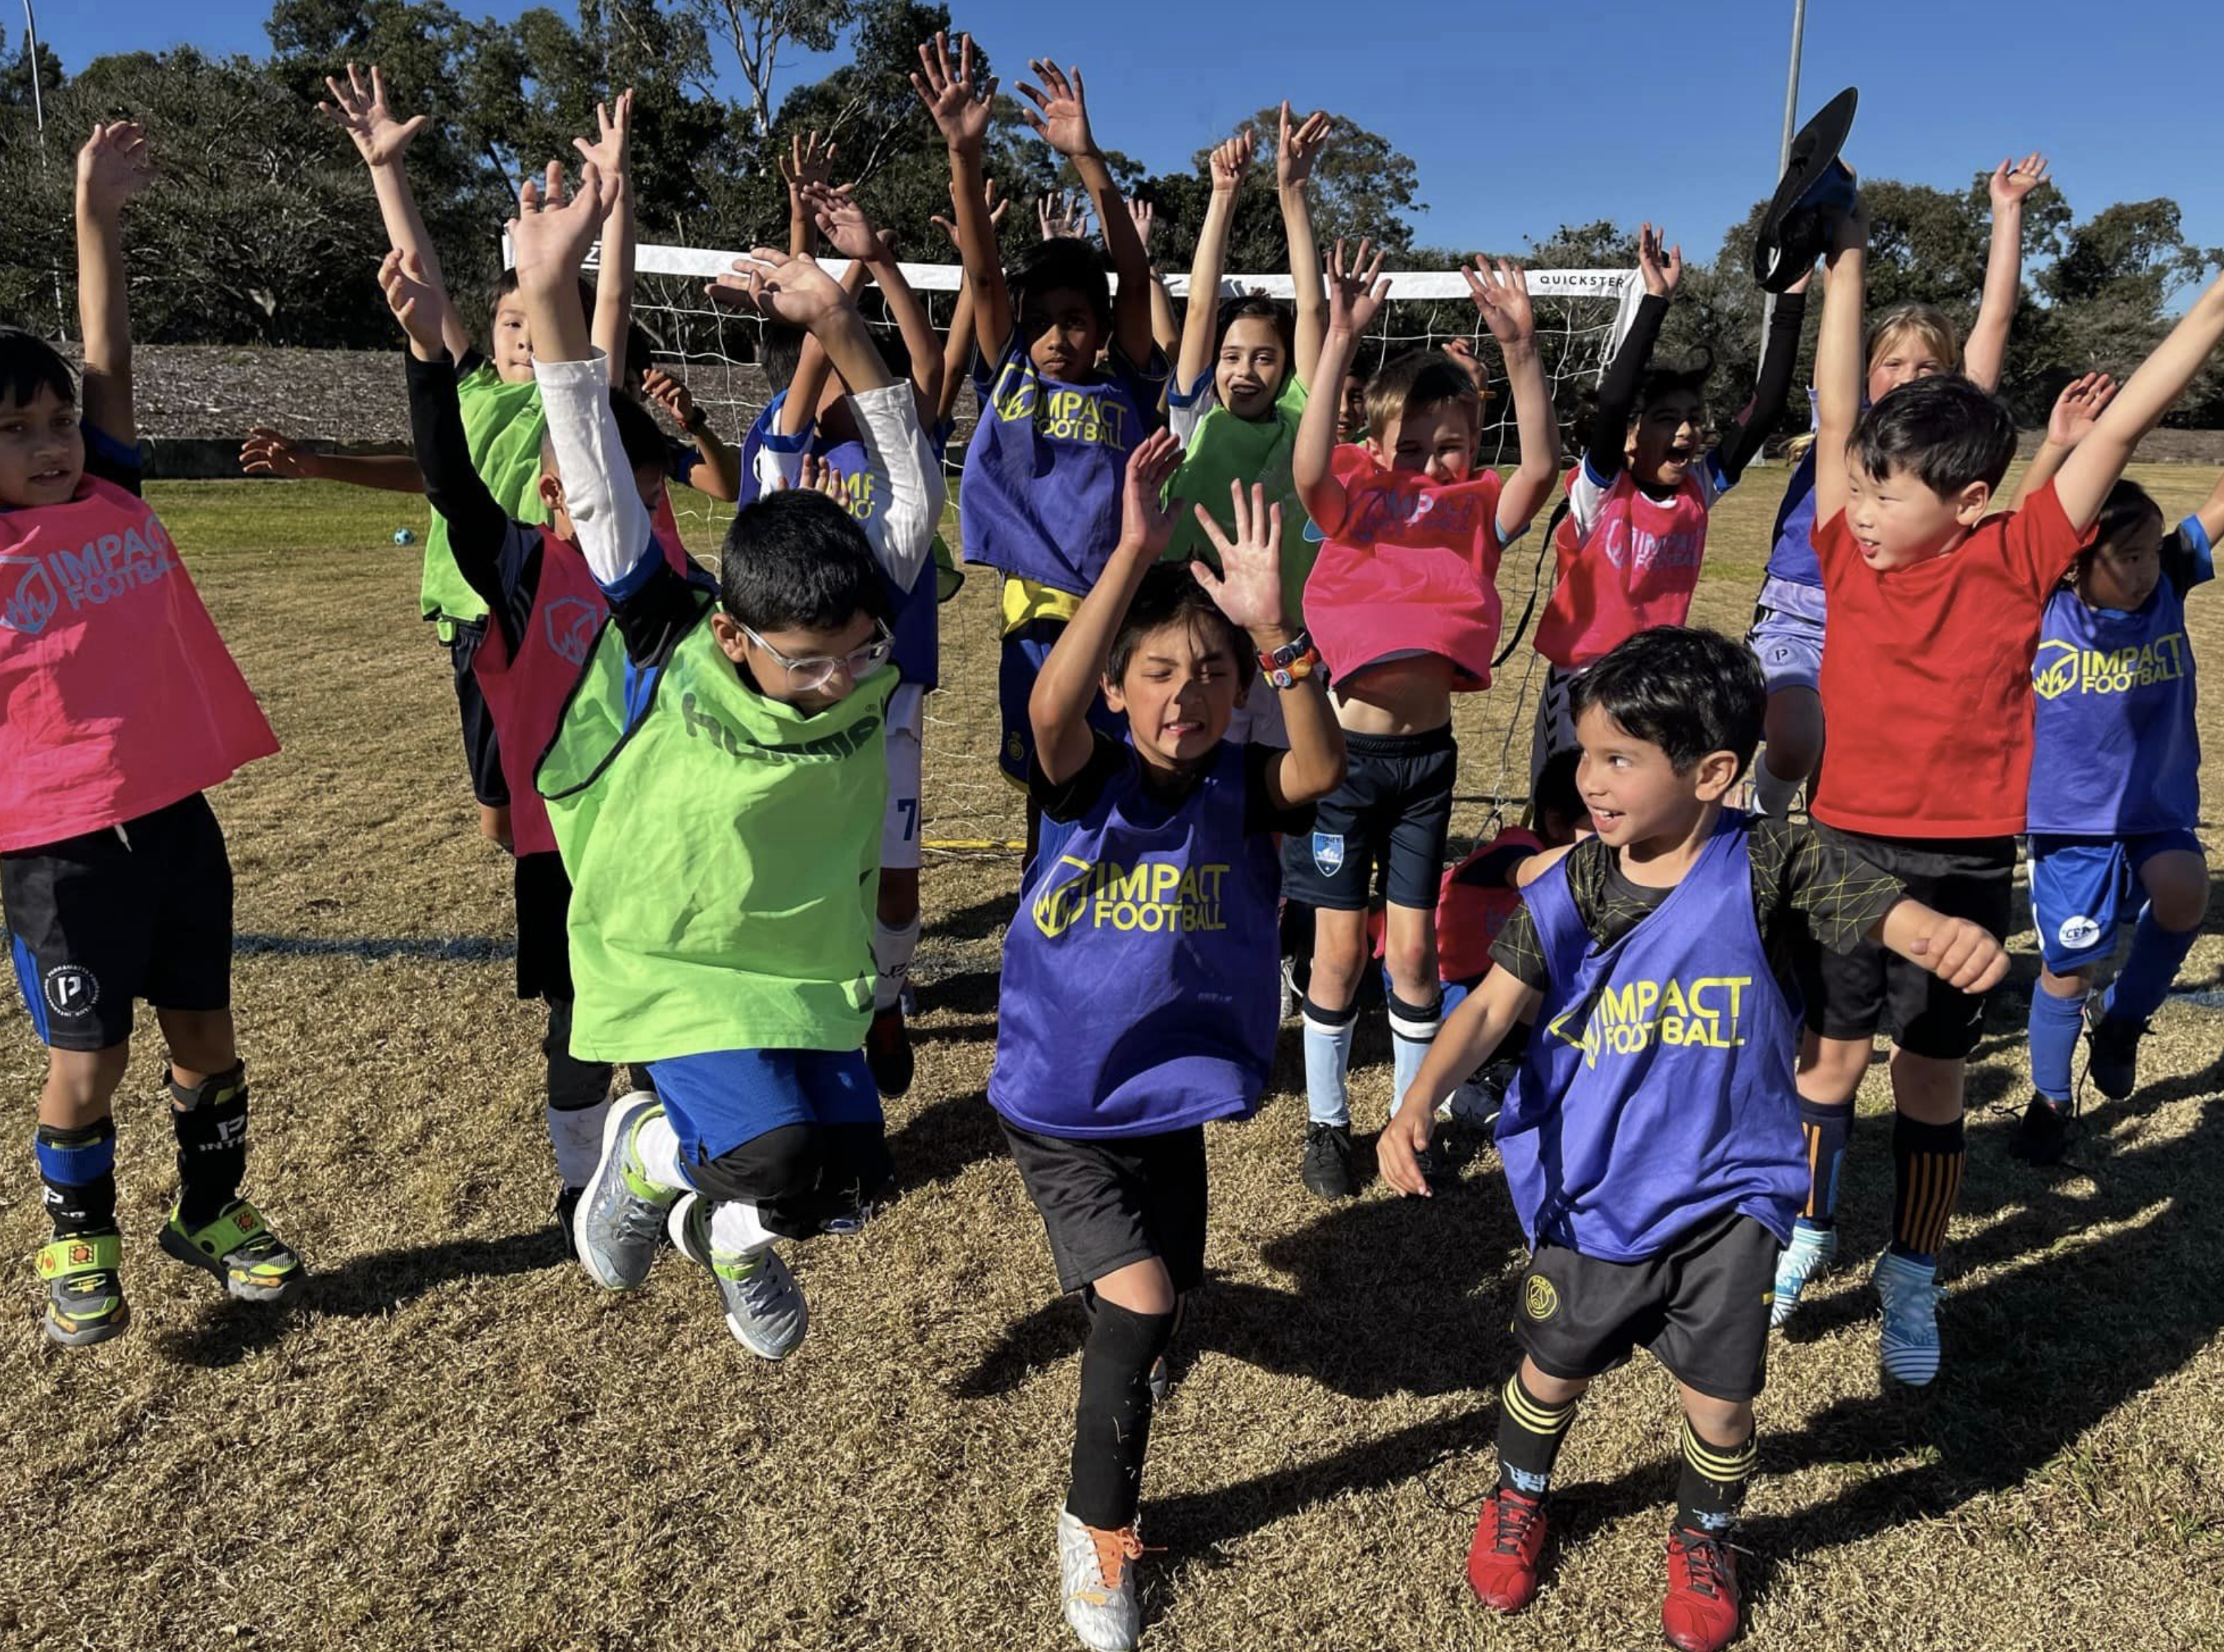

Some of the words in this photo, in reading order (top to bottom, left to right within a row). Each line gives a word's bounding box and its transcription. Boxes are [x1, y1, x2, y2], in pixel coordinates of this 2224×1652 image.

[1540, 275, 1625, 288] QUICKSTER
[47, 513, 170, 587] IMPAC
[2081, 632, 2183, 676] IMPACT
[2081, 658, 2184, 695] FOOTBALL
[1095, 862, 1230, 903] IMPACT
[1093, 900, 1227, 932] FOOTBALL
[1599, 976, 1752, 1026] IMPACT
[1604, 1015, 1746, 1055] FOOTBALL
